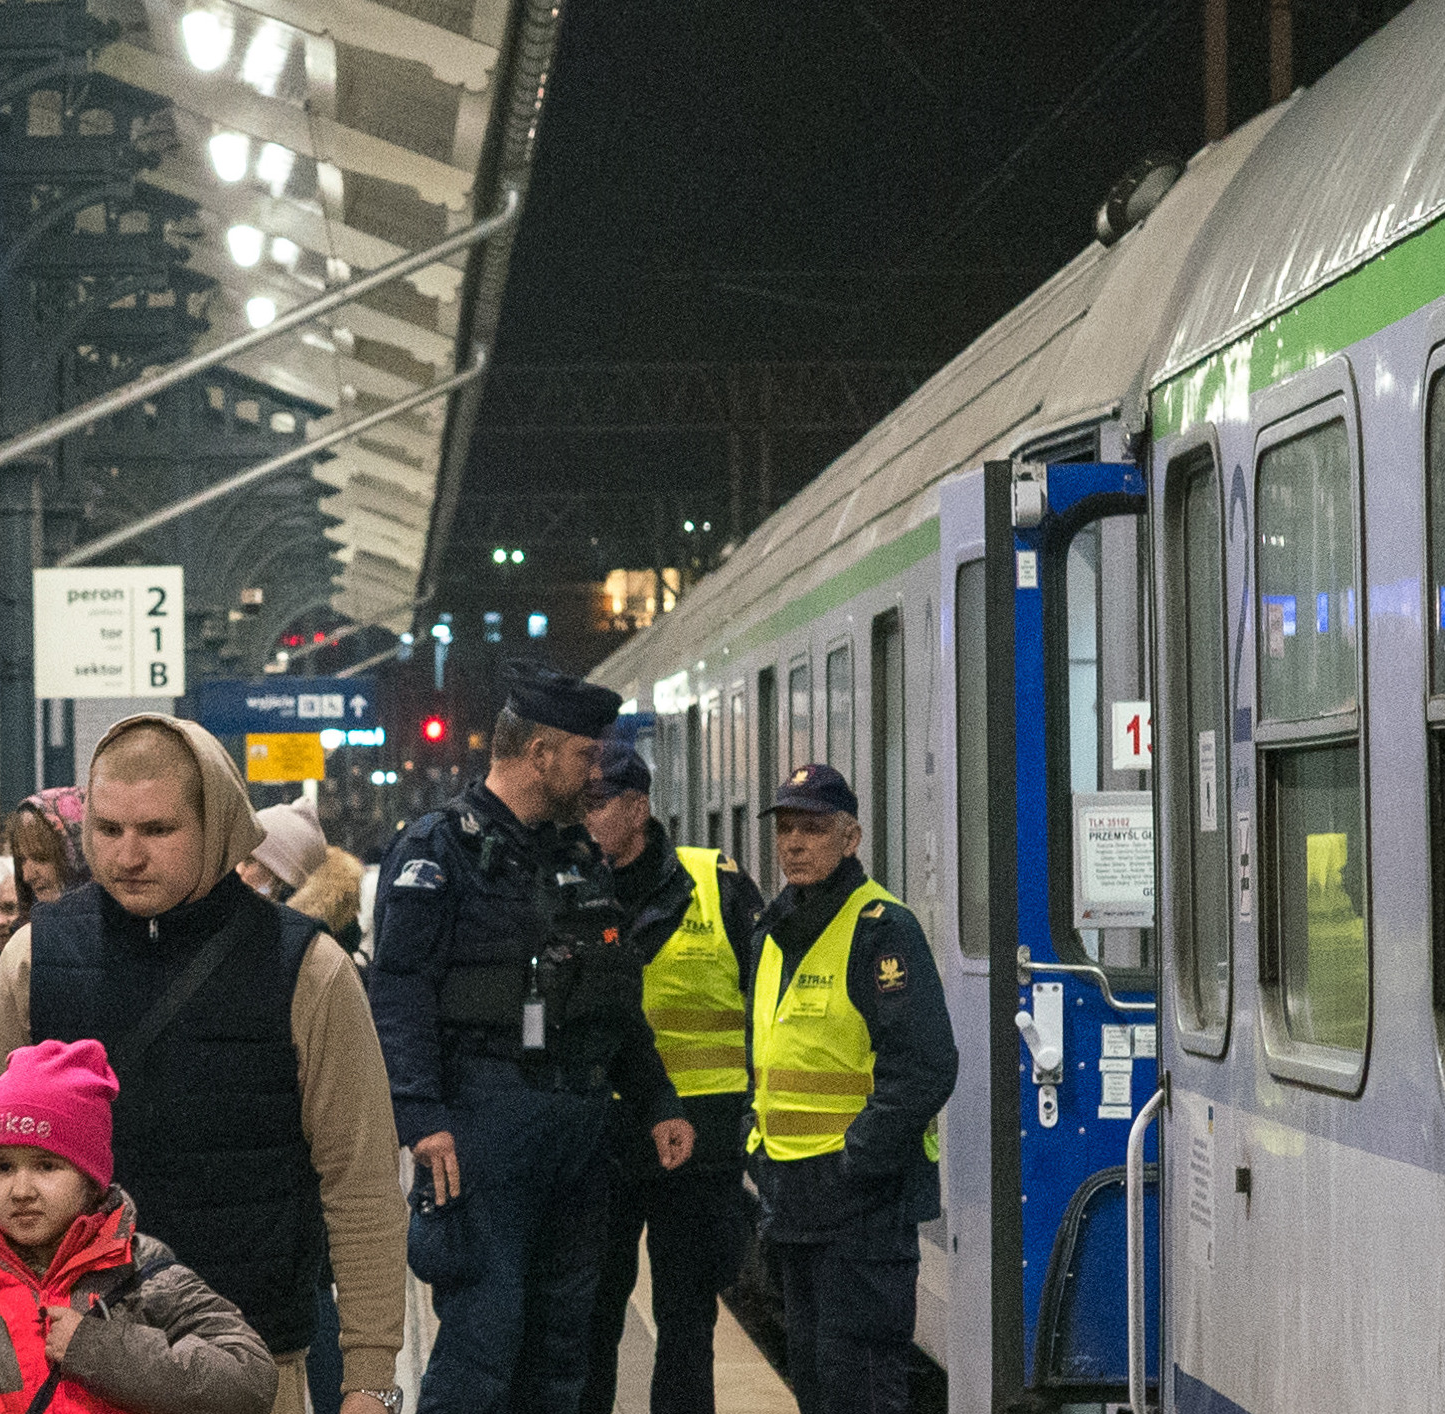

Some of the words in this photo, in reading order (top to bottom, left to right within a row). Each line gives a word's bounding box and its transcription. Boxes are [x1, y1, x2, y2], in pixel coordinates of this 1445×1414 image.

[67, 588, 125, 605] peron
[147, 586, 167, 616] 2
[100, 627, 123, 640] tor
[150, 626, 162, 652] 1
[75, 663, 123, 676] sektor
[149, 661, 169, 688] B
[1089, 829, 1140, 841] PRZEMYŚL
